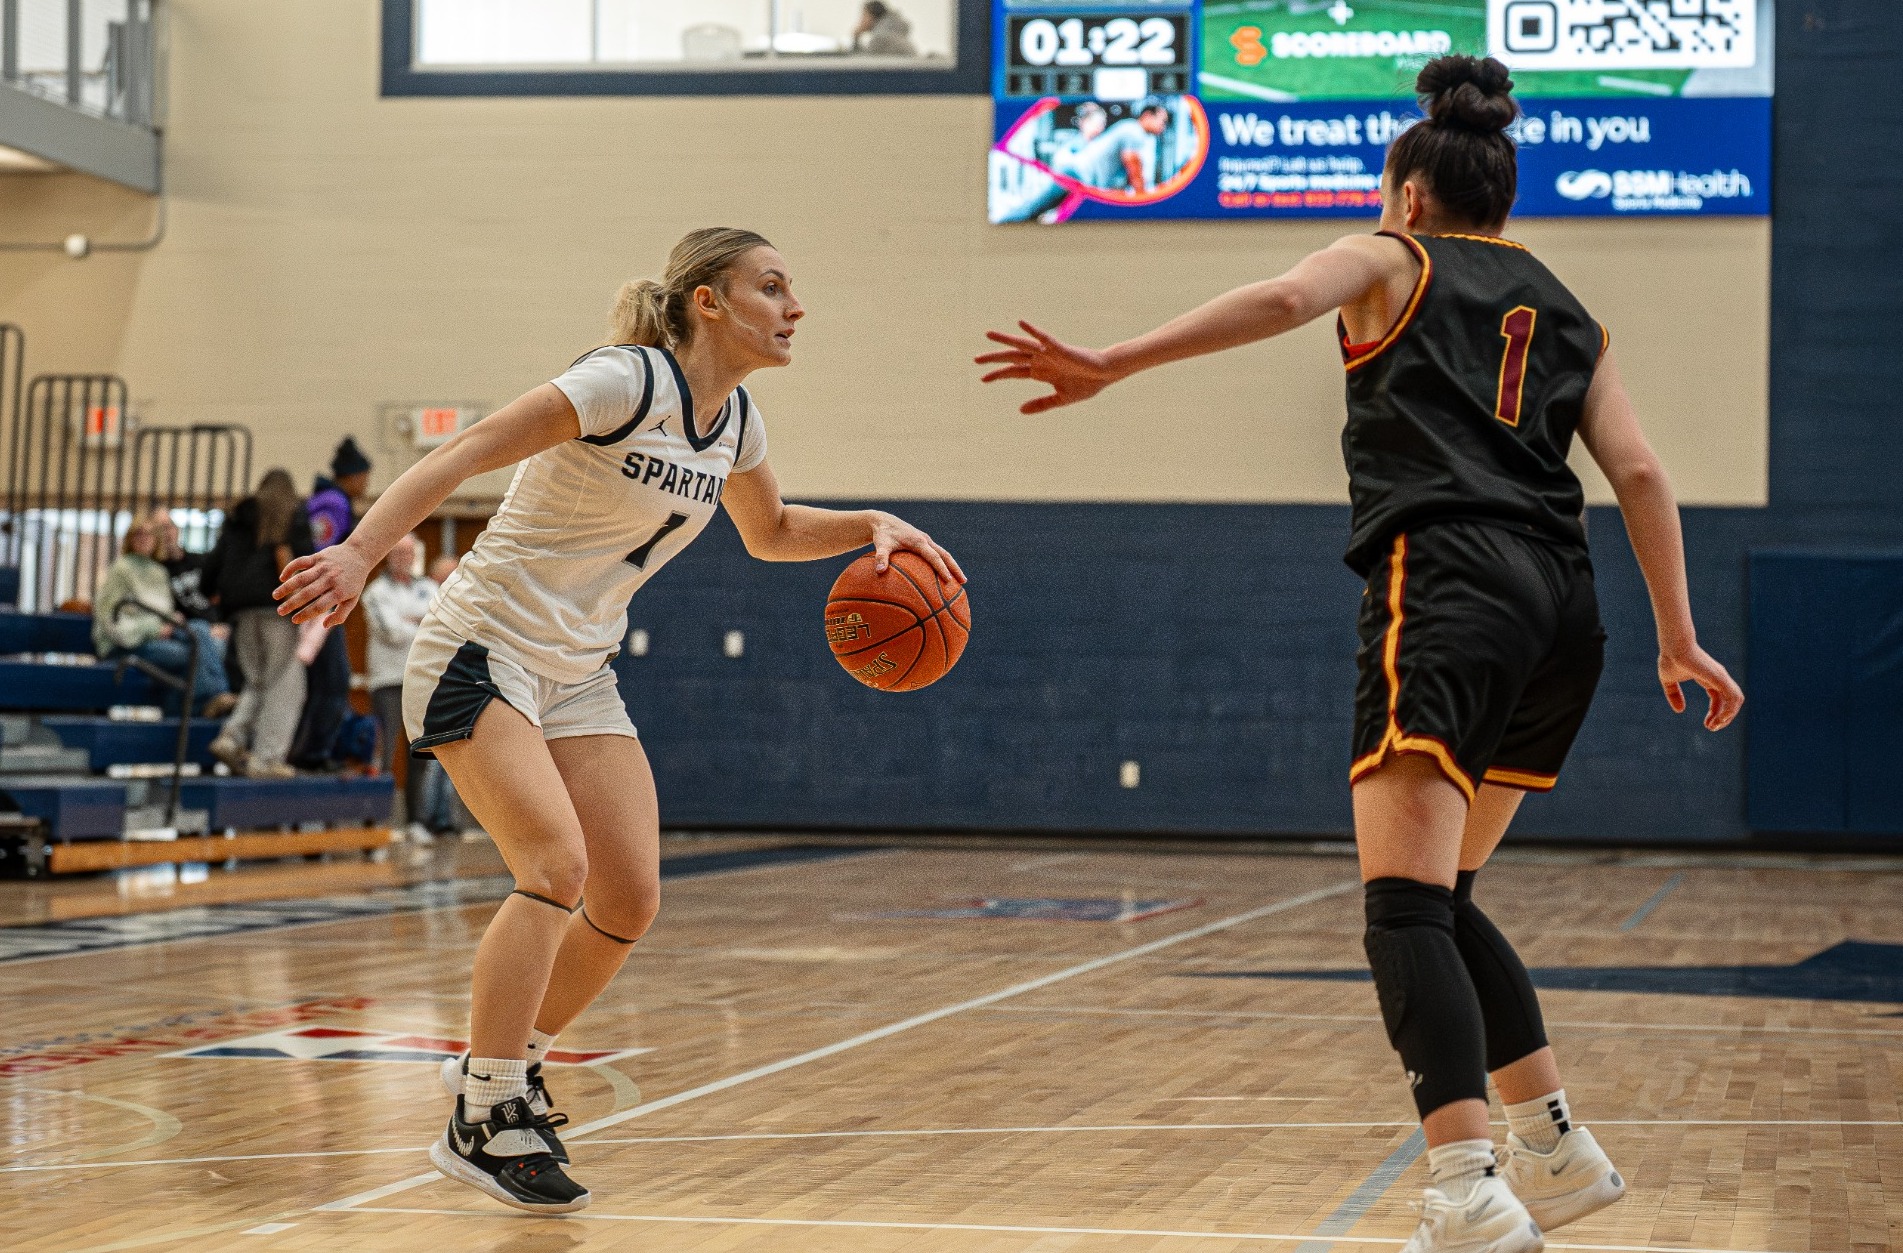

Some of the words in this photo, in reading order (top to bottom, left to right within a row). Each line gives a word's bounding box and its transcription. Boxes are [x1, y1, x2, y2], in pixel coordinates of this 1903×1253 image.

[1020, 17, 1176, 65] 01:22
[1271, 30, 1452, 58] SCOREBOARD
[1218, 112, 1275, 147] We
[1277, 114, 1363, 147] treat
[1550, 110, 1583, 144] in
[1585, 115, 1652, 150] you
[1495, 305, 1537, 427] 1
[621, 510, 690, 573] 1
